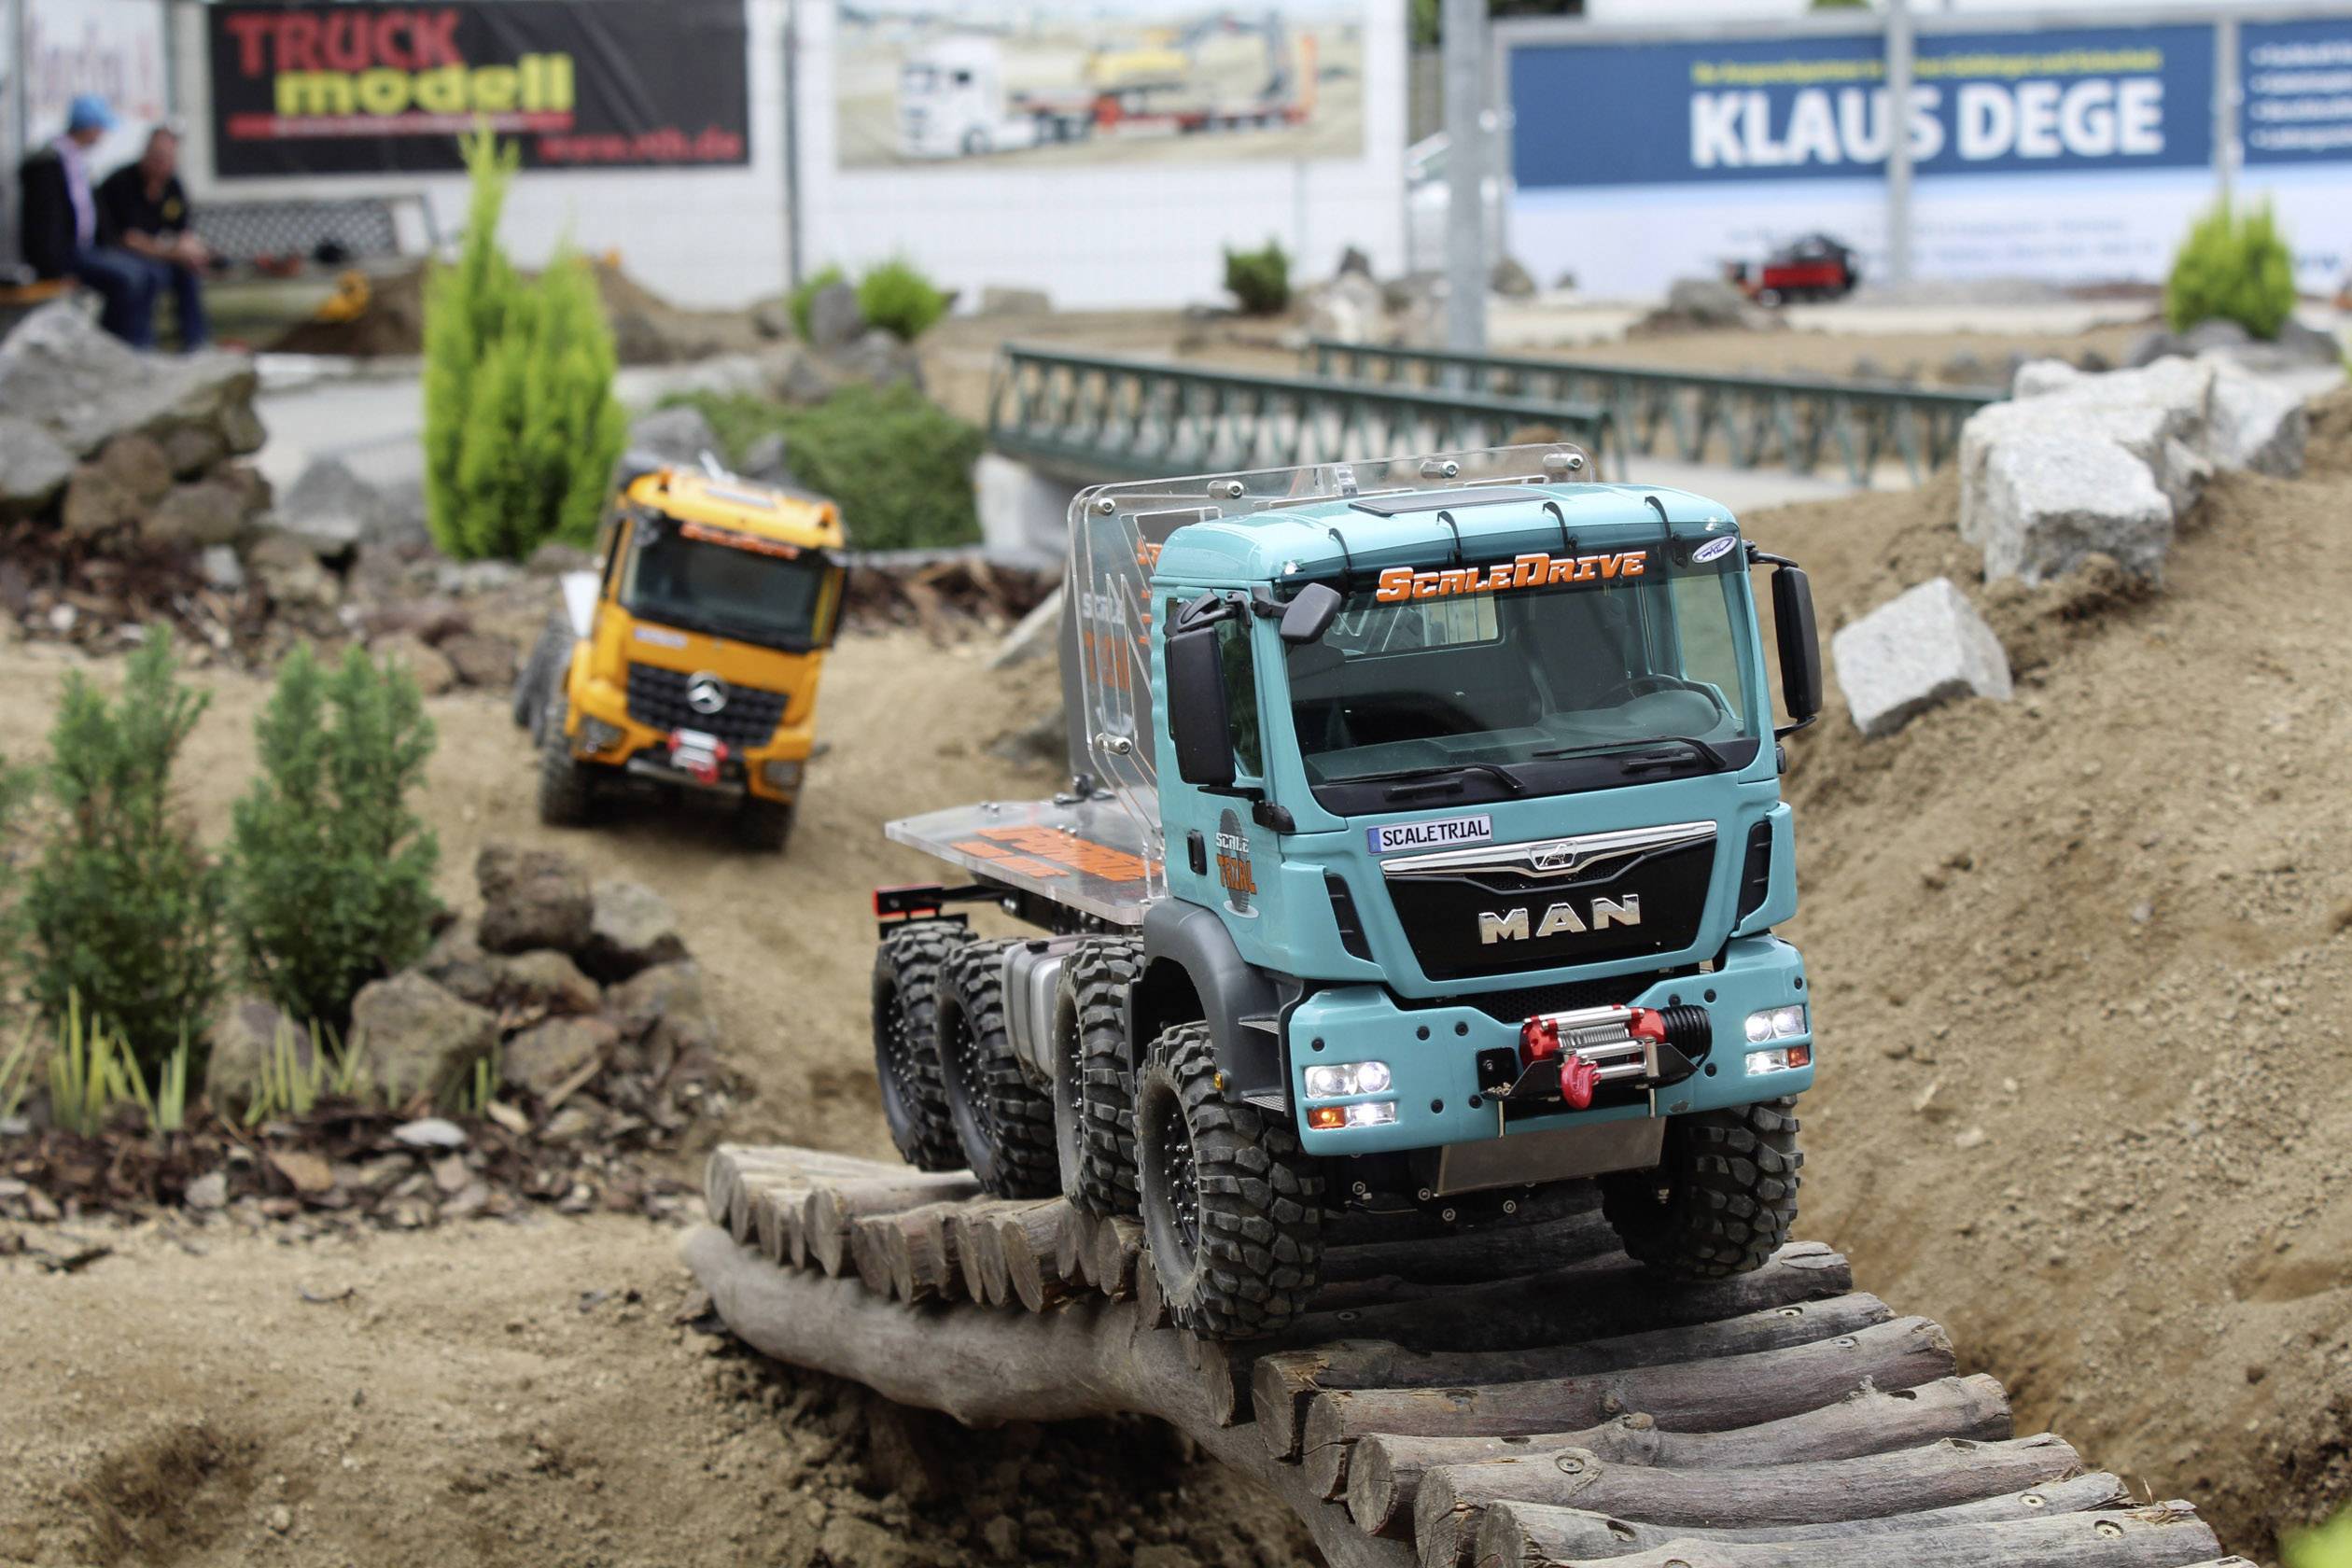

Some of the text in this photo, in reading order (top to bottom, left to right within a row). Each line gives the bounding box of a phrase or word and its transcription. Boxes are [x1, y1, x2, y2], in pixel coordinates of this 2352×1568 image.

[227, 10, 462, 77] TRUCK
[275, 53, 574, 117] modell
[1690, 78, 2164, 166] KLAUS DEGE
[1216, 833, 1249, 852] SCALE
[1382, 820, 1490, 847] SCALETRIAL
[1217, 853, 1257, 895] TRIAL
[1478, 893, 1641, 945] MAN
